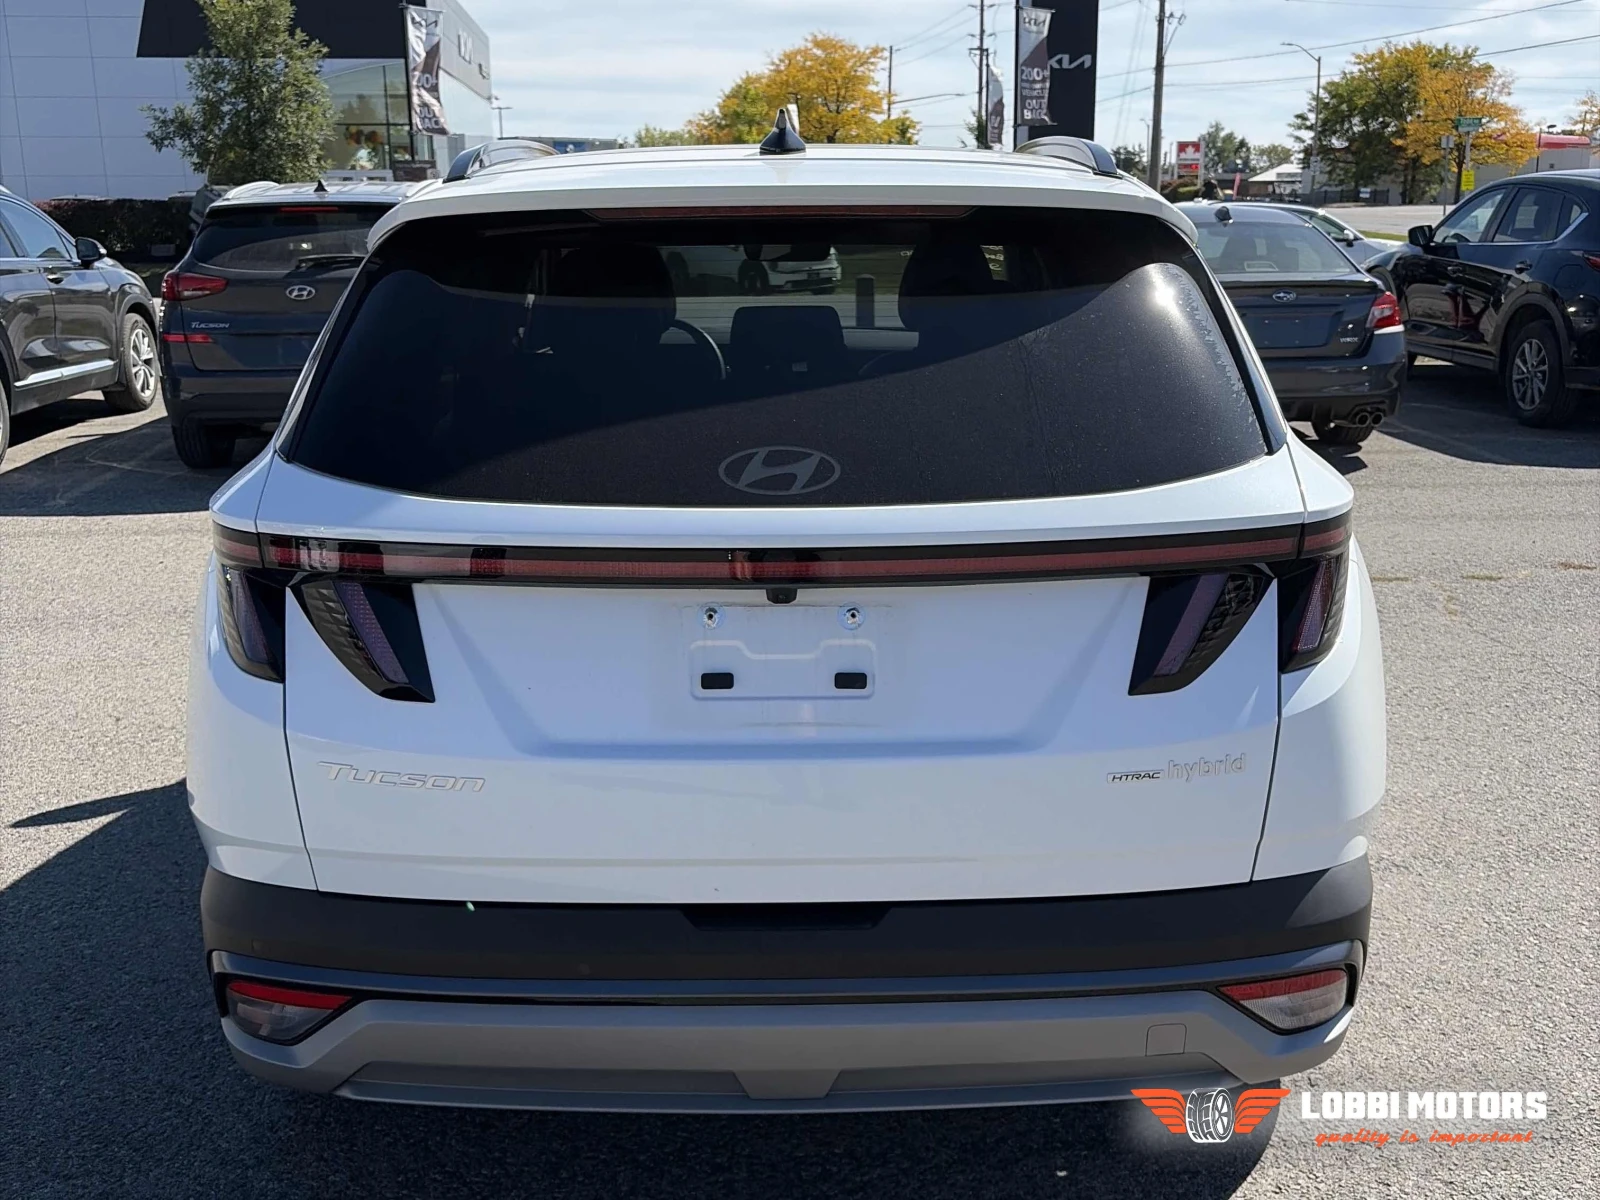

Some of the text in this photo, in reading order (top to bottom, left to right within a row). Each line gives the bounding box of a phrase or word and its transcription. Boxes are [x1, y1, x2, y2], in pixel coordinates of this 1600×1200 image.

[1021, 66, 1049, 80] 200+
[1111, 752, 1247, 783] HTRAC hybrid
